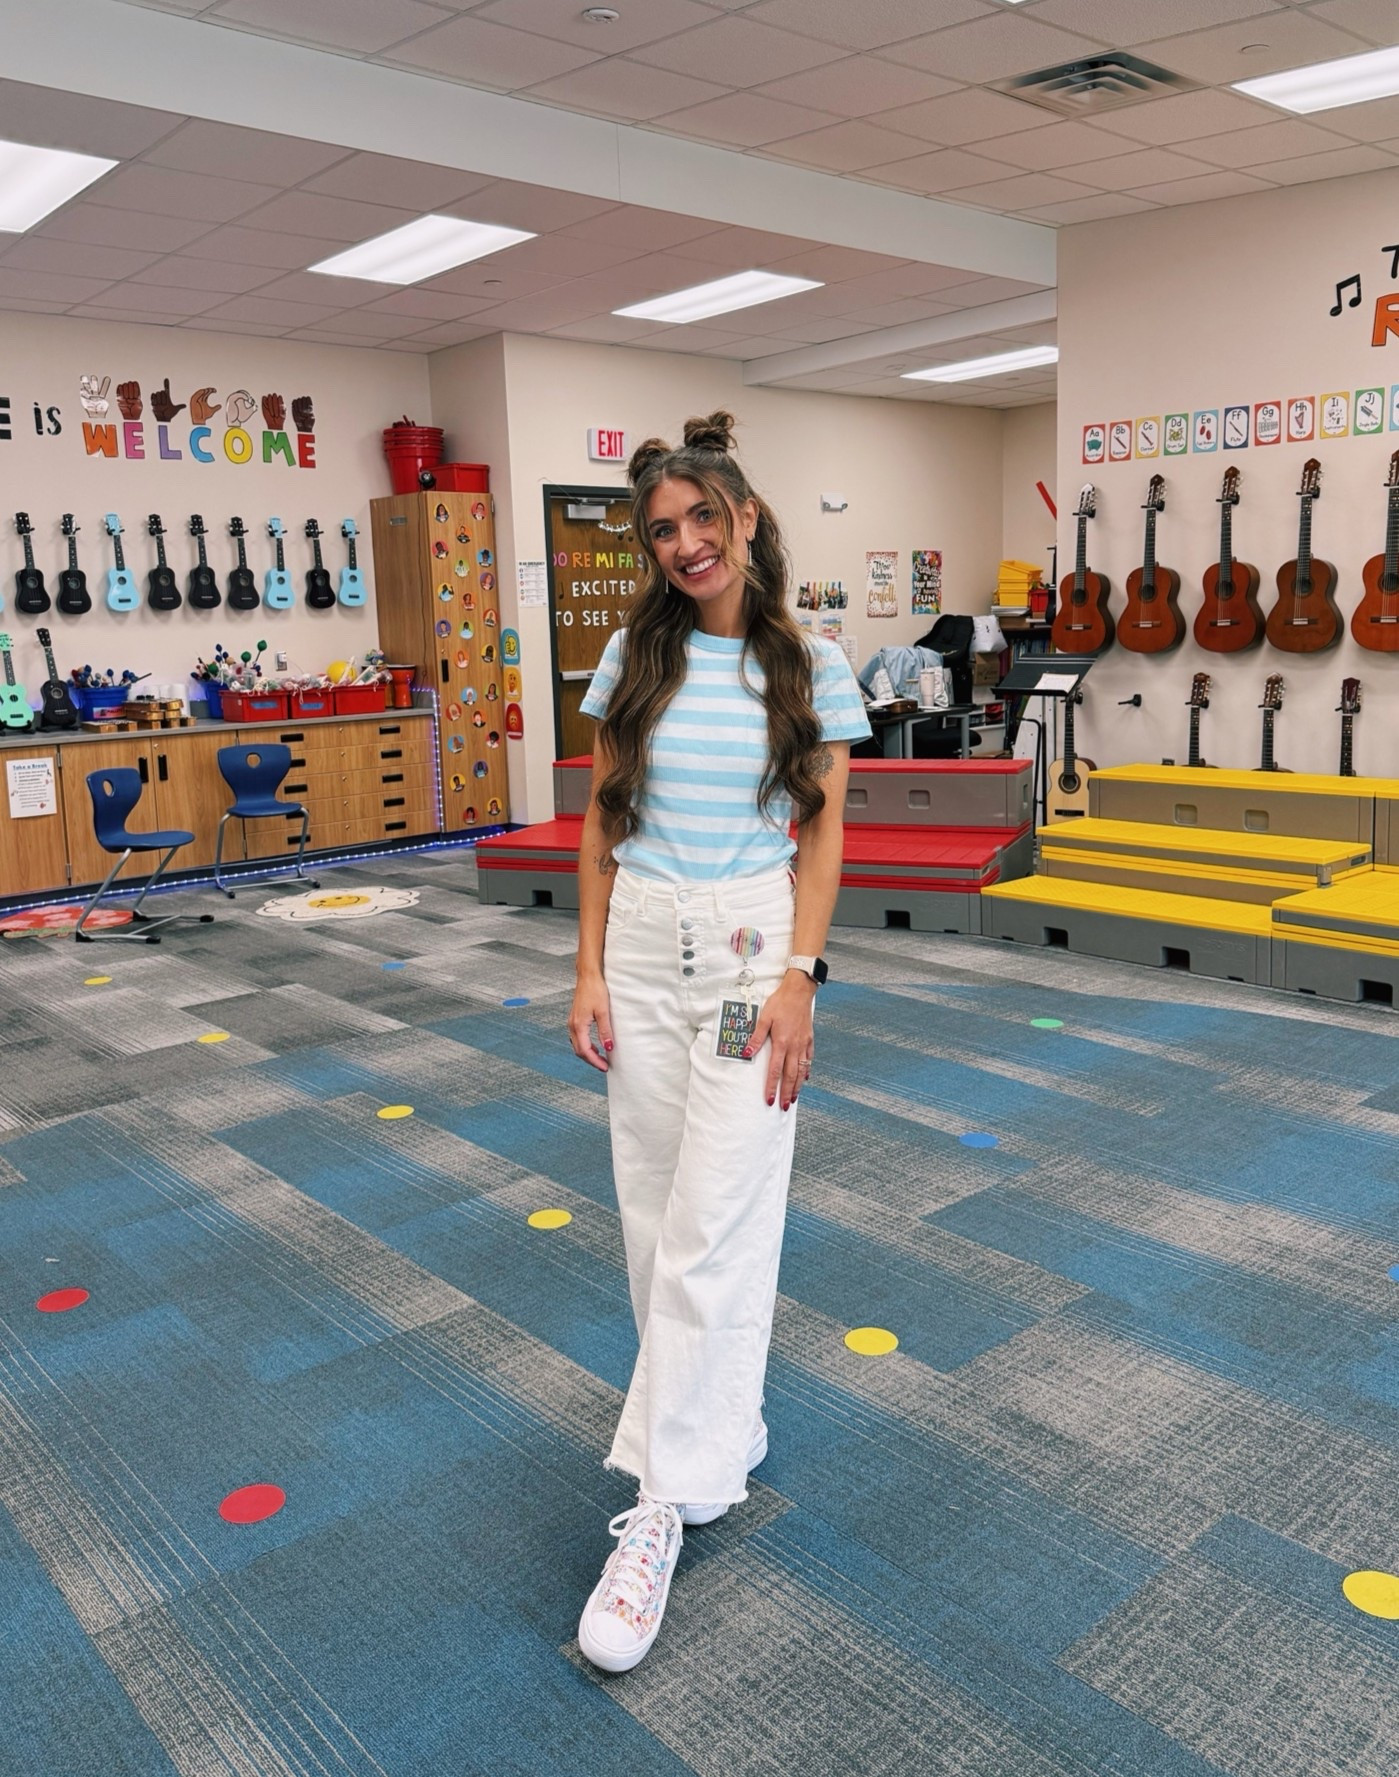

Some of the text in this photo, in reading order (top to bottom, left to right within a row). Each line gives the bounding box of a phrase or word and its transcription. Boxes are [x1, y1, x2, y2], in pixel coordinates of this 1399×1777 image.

[1331, 397, 1339, 407] Ii
[1364, 392, 1375, 405] Jj
[1262, 406, 1274, 417] Gg
[1295, 402, 1307, 412] Hh
[1201, 415, 1211, 424] Ee
[1231, 410, 1242, 420] Ff
[1142, 422, 1153, 431] Cc
[1171, 418, 1182, 428] Dd
[1089, 429, 1100, 437] Aa
[1115, 425, 1126, 434] Bb
[33, 402, 62, 436] is
[82, 421, 316, 469] WELCOME
[598, 430, 624, 457] EXIT
[572, 552, 591, 568] RE
[596, 552, 614, 568] MI
[618, 553, 634, 568] FA
[572, 579, 637, 597] EXCITED
[916, 594, 935, 603] FUN
[555, 610, 574, 627] TO
[582, 610, 609, 626] SEE
[725, 1002, 739, 1017] I'M
[723, 1016, 754, 1031] HAPPY
